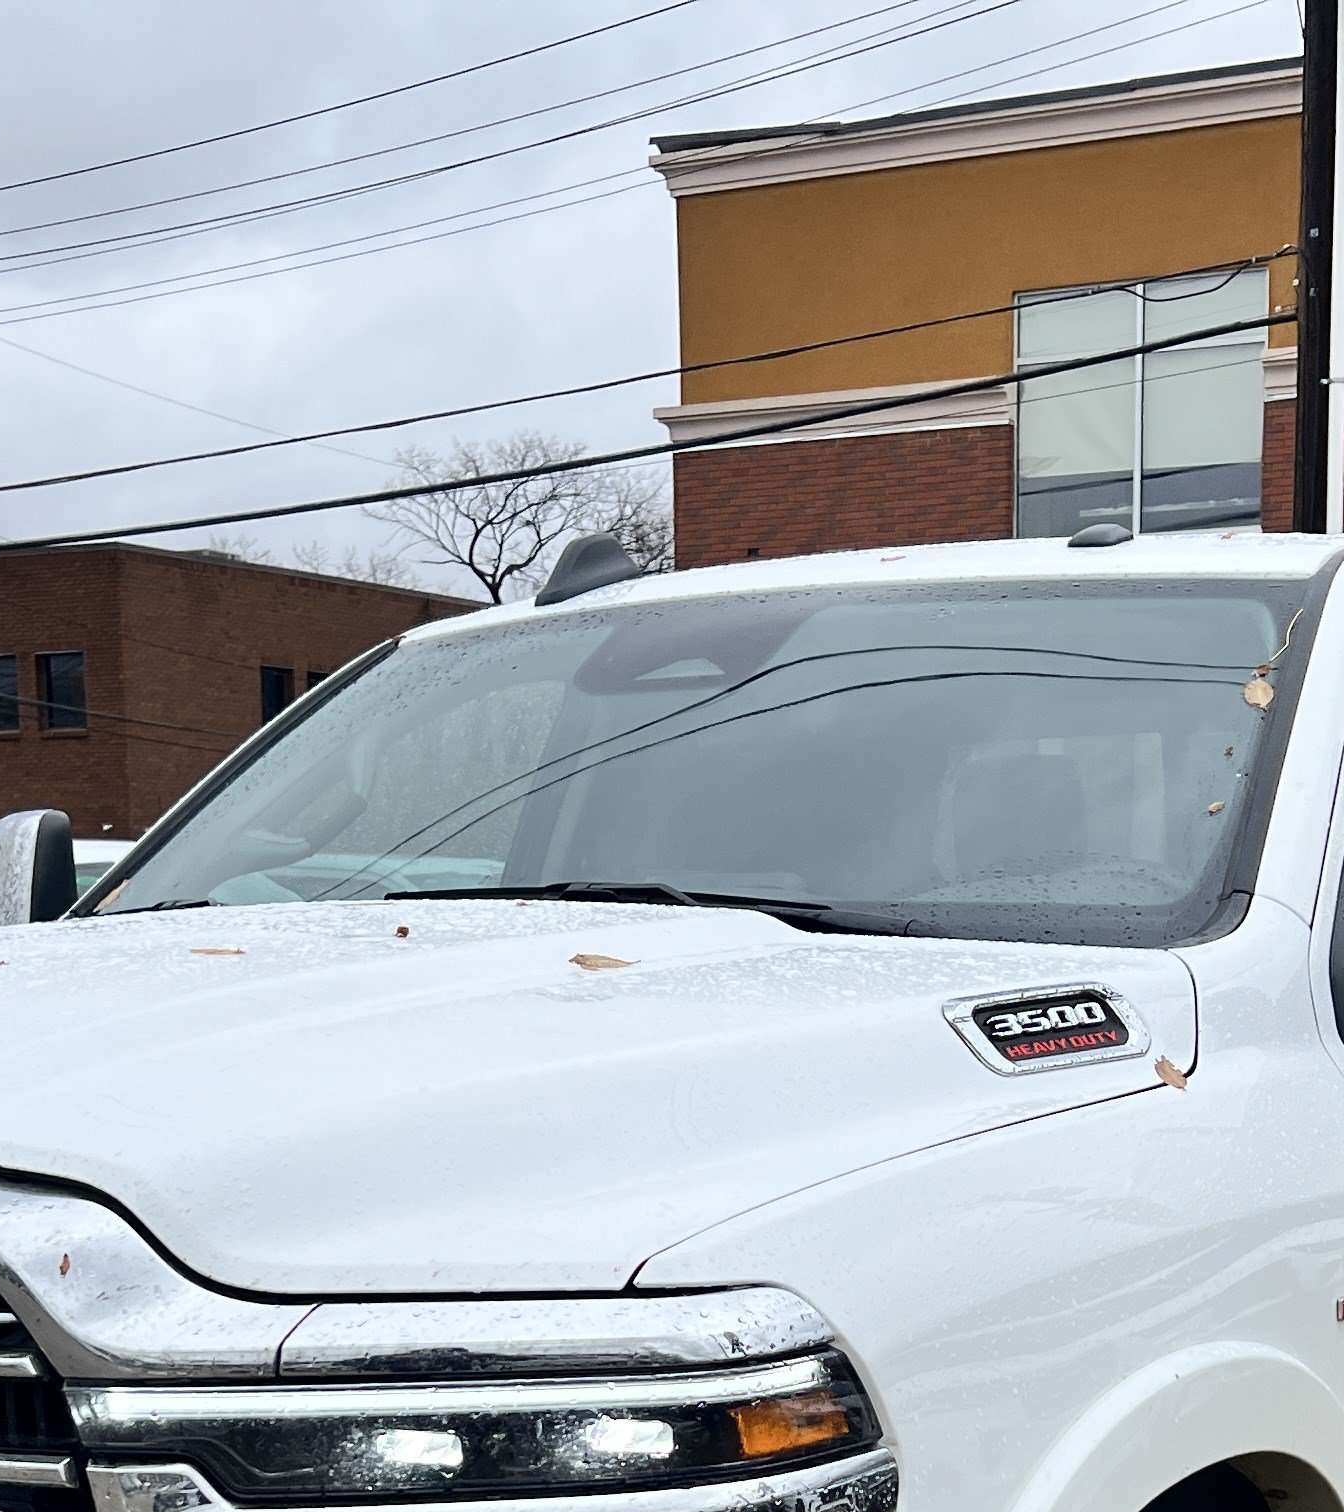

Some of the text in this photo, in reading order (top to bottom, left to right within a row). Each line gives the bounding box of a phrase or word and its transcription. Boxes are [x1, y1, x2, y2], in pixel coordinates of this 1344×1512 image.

[985, 1001, 1107, 1038] 3500
[1006, 1030, 1118, 1058] HEAVY DUTY
